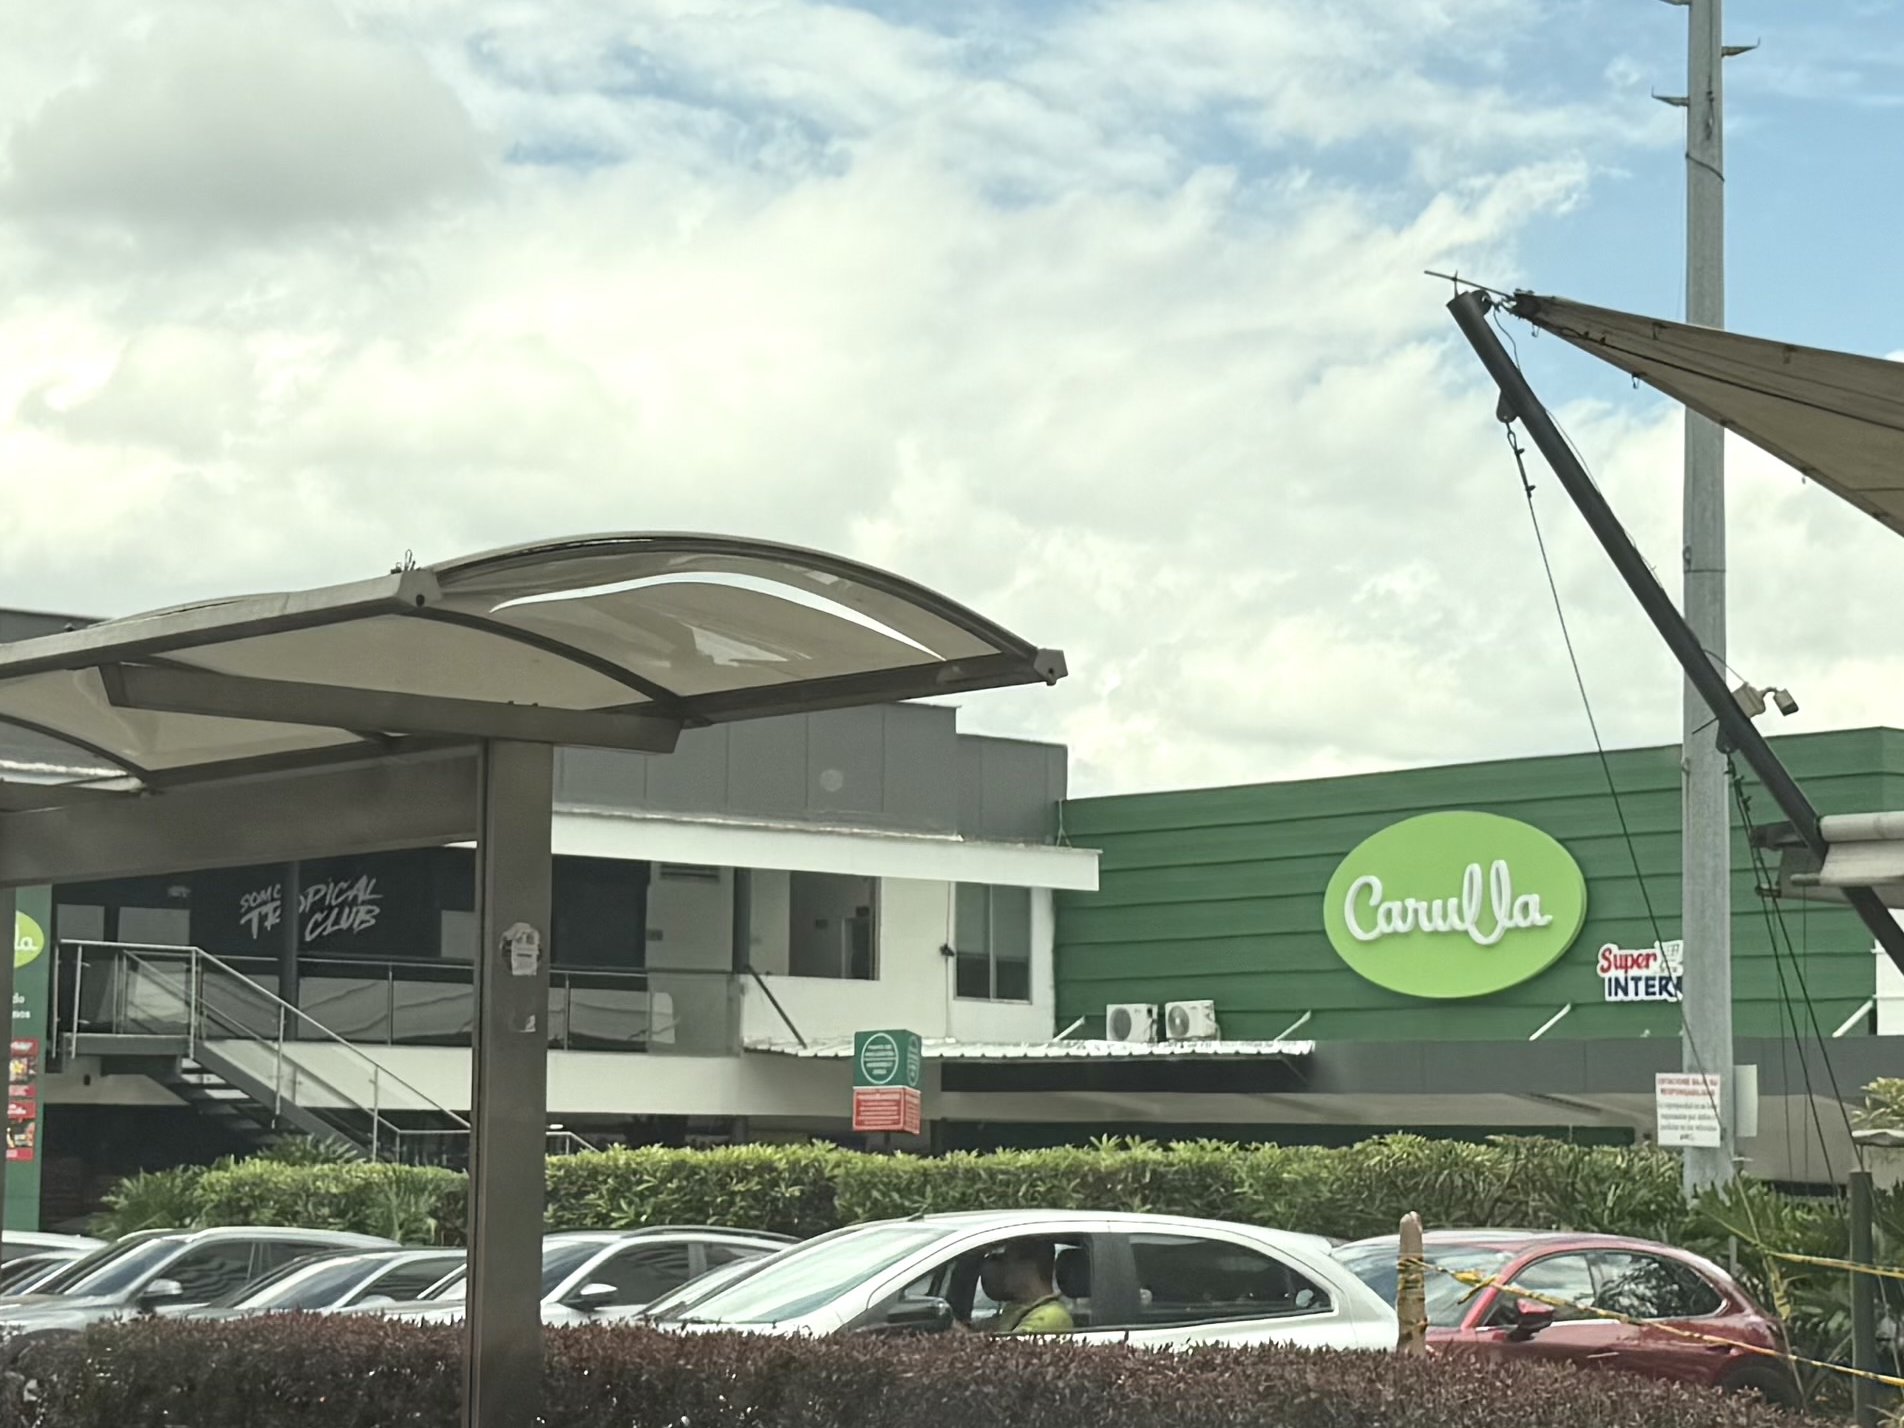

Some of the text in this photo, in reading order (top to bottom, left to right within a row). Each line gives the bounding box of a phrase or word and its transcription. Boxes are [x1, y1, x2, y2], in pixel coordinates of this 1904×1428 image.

[1344, 859, 1554, 945] Carulla
[304, 905, 380, 942] CLUB
[1600, 947, 1658, 974] Super
[1608, 975, 1677, 998] INTER
